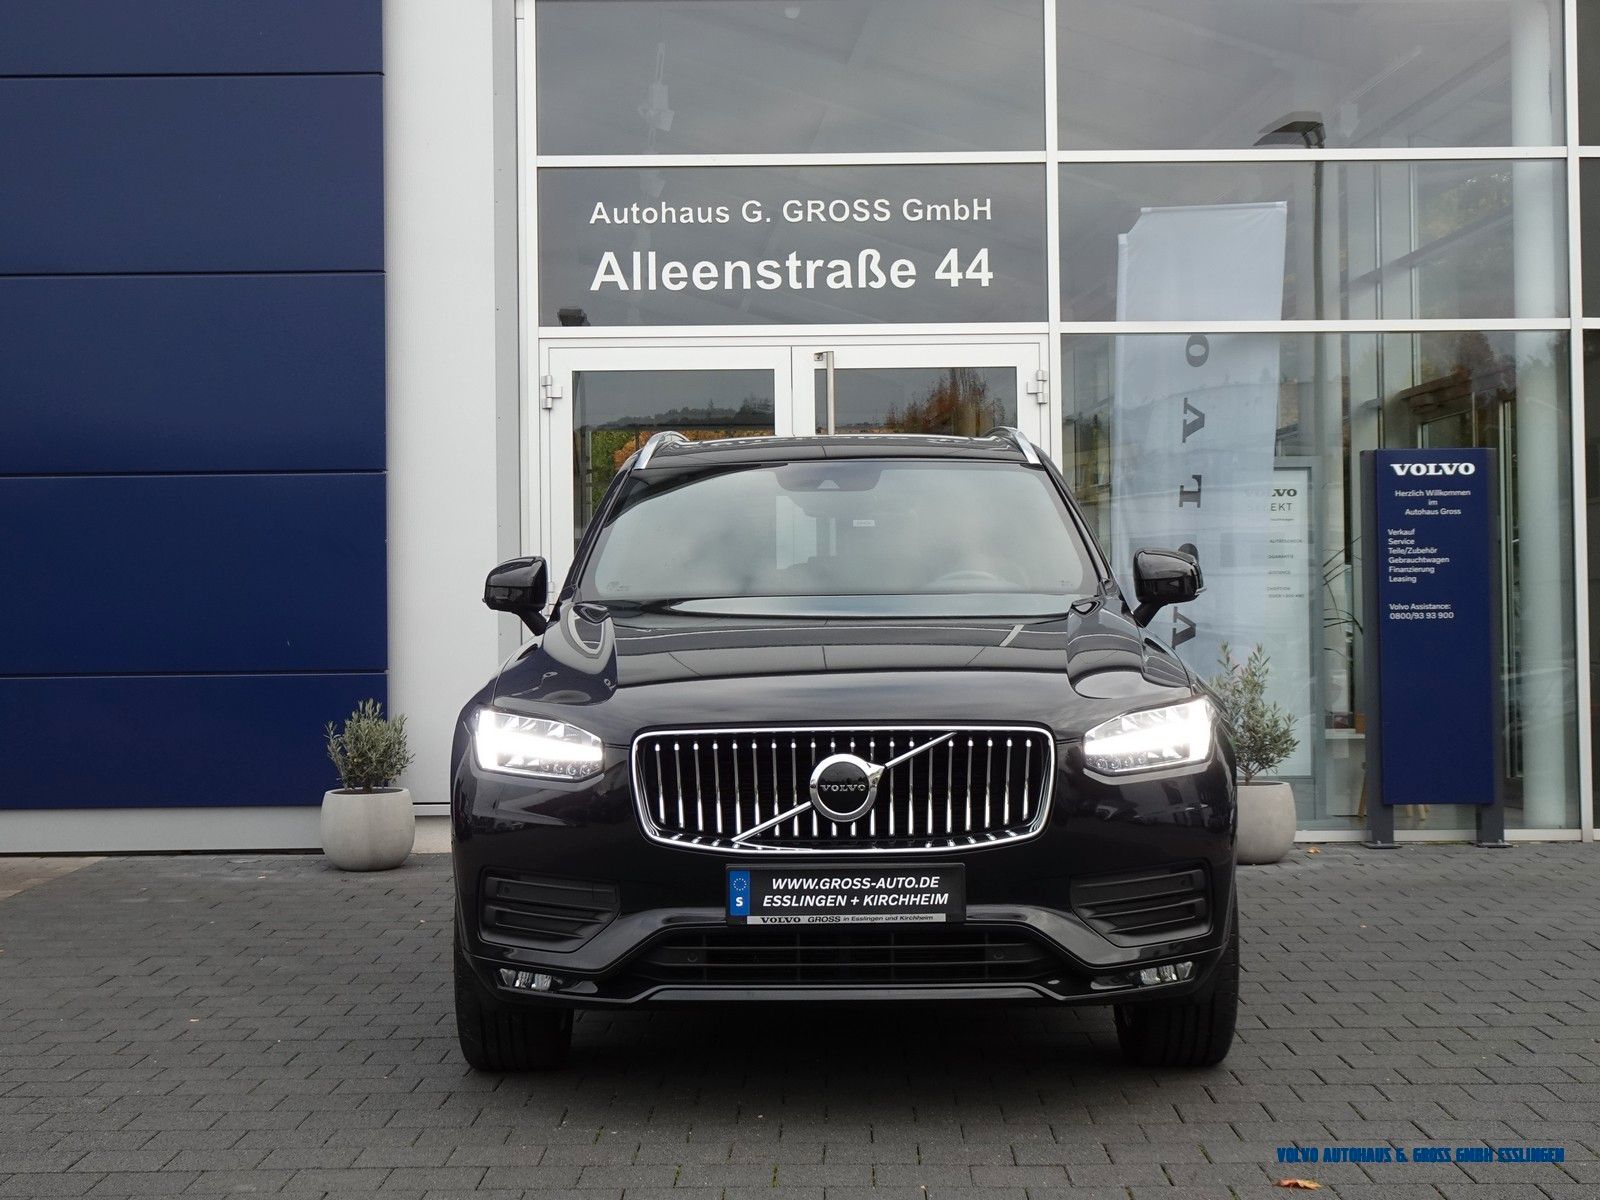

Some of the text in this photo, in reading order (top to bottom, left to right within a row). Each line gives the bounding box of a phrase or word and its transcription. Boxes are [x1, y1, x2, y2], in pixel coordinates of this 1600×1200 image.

[589, 198, 992, 225] Autohaus G. GROSS GmbH
[590, 247, 994, 291] Alleenstraße 44
[1390, 462, 1476, 476] VOLVO
[1394, 489, 1472, 498] Herzlich Willkommen
[1404, 508, 1439, 516] Autohaus
[1387, 528, 1416, 536] Verkauf
[1388, 538, 1415, 546] Service
[1388, 547, 1438, 555] Teile/Zubehör
[1388, 556, 1450, 566] Gebrauchtwagen
[1388, 565, 1436, 575] Finanzierung
[1388, 575, 1417, 585] Leasing
[1389, 602, 1452, 611] Volvo Assistance:
[1389, 611, 1455, 621] 0800/93 93 900
[820, 784, 867, 792] VOLVO
[771, 876, 940, 890] WWW.GROSS-AUTO.DE
[735, 897, 744, 907] S
[762, 894, 847, 907] ESSLINGEN
[863, 893, 949, 906] KIRCHHEIM
[761, 916, 801, 924] VOLVO
